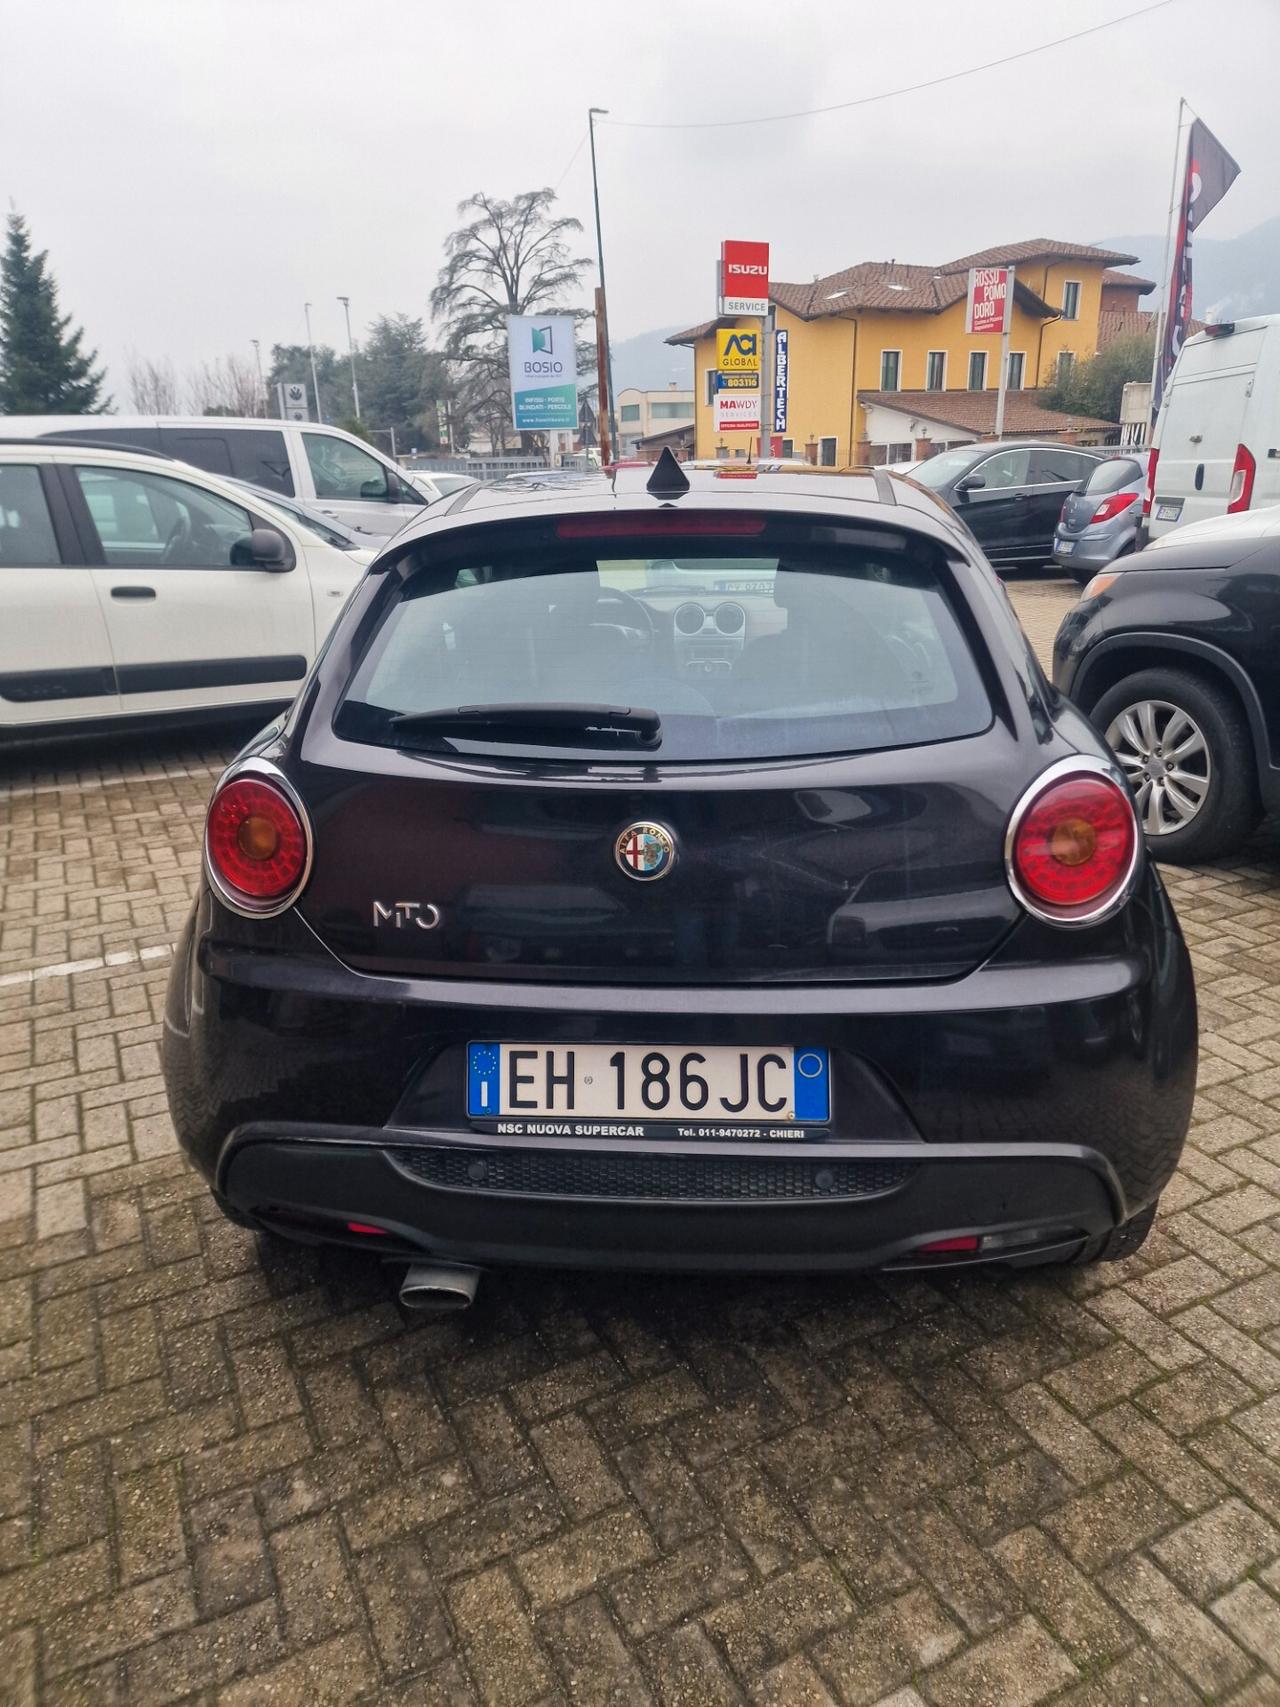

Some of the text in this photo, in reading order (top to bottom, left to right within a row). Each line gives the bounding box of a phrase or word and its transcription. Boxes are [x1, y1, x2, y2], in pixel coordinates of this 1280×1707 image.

[728, 264, 767, 275] ISUZU
[984, 283, 1006, 301] POMO
[728, 301, 766, 311] SERVICE
[974, 301, 995, 319] DORO
[524, 361, 563, 373] BOSIO
[723, 358, 757, 367] GLOBAL
[776, 331, 787, 431] ALBERTECH
[720, 400, 758, 409] MAWDY
[509, 1051, 575, 1109] EH
[497, 1124, 644, 1137] NSC NUOVA SUPERCAR
[678, 1128, 696, 1136] Tel.
[698, 1129, 760, 1138] 011-9470272
[769, 1130, 805, 1138] CHIERI
